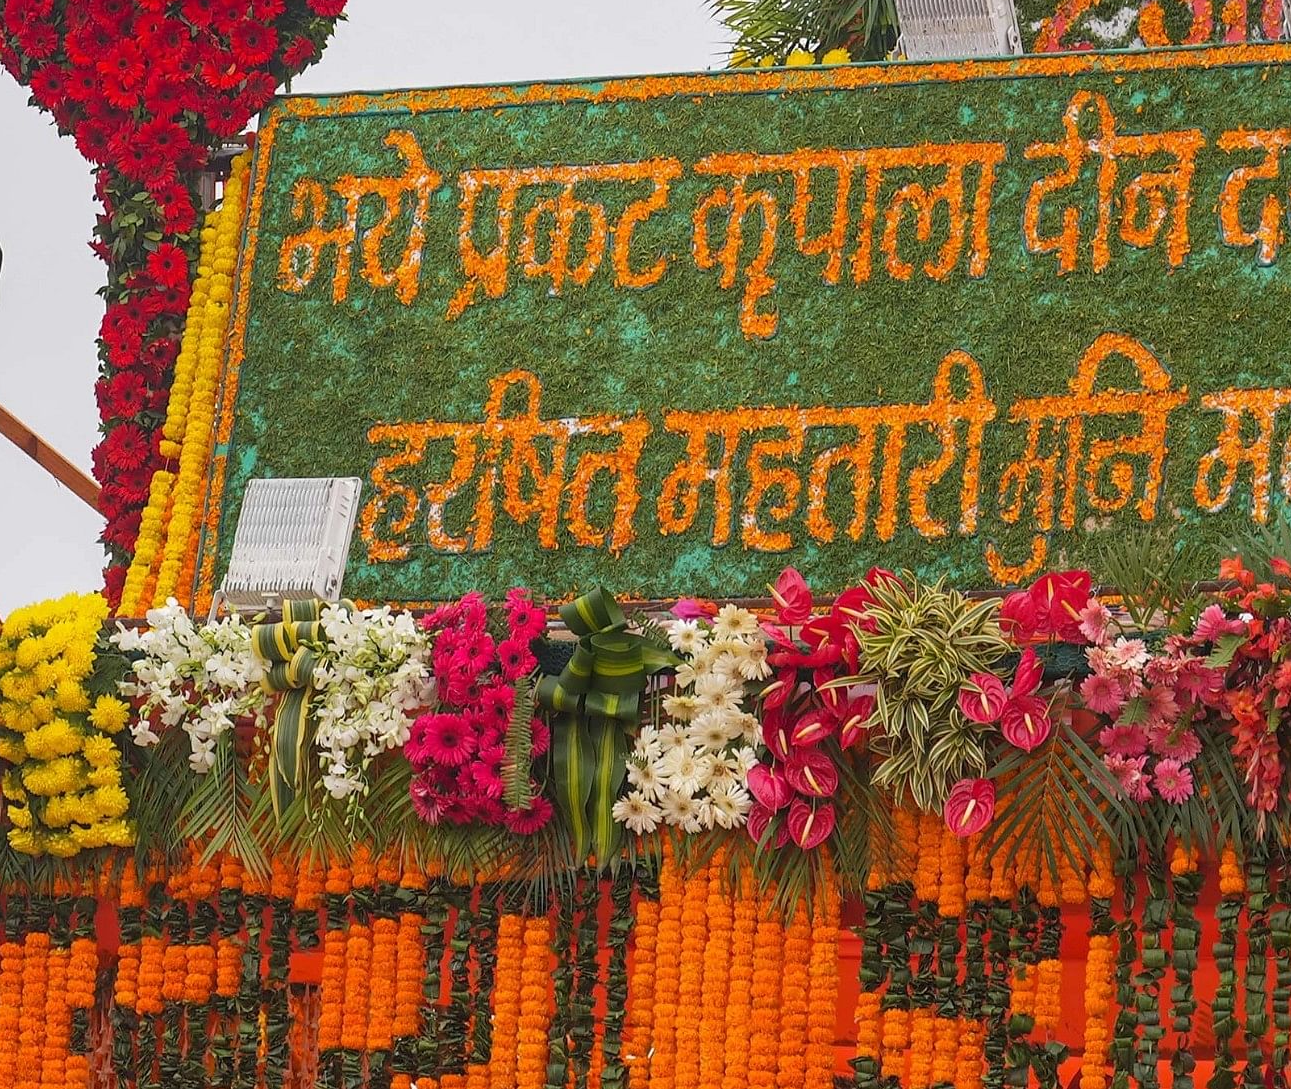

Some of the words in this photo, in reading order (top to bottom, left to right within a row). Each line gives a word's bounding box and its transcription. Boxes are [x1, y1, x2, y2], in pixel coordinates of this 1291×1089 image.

[277, 129, 443, 305] भये
[445, 155, 682, 321] प्रकट
[692, 140, 1006, 340] कृपाला
[1023, 90, 1205, 274] दीन
[359, 368, 651, 565] हरषित
[659, 349, 996, 551] महतारी
[985, 332, 1188, 586] मुनि
